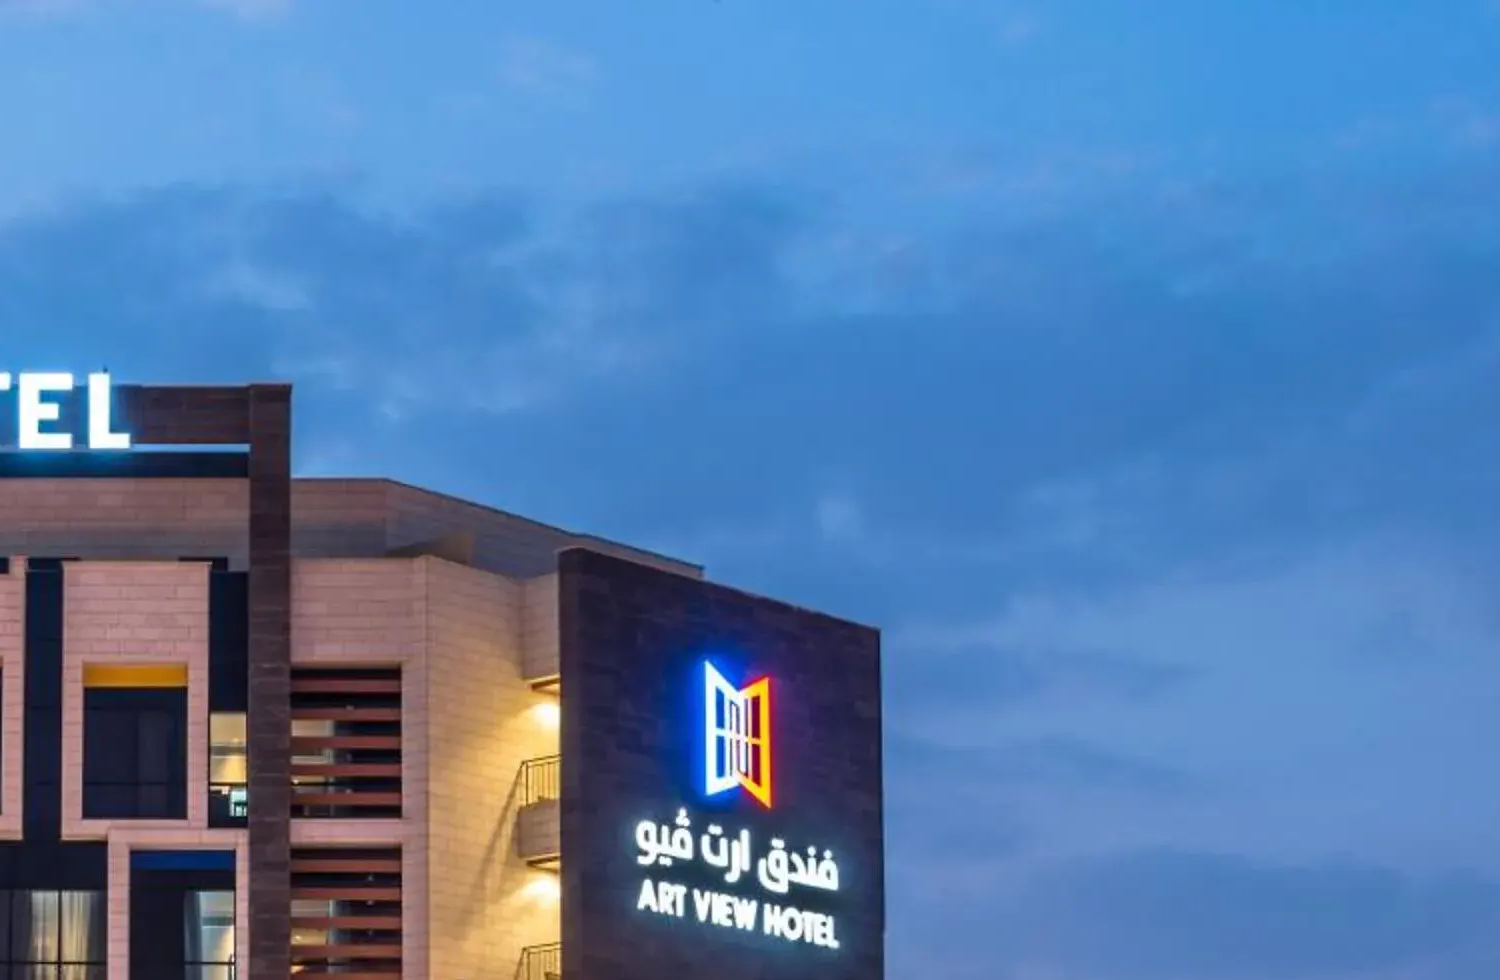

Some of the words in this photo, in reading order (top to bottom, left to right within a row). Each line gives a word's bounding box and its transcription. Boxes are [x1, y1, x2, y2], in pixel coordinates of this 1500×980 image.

[701, 824, 751, 883] ارت
[757, 838, 840, 894] فندق
[637, 879, 688, 917] ART
[692, 888, 758, 931] VIEW
[763, 903, 840, 949] HOTEL
